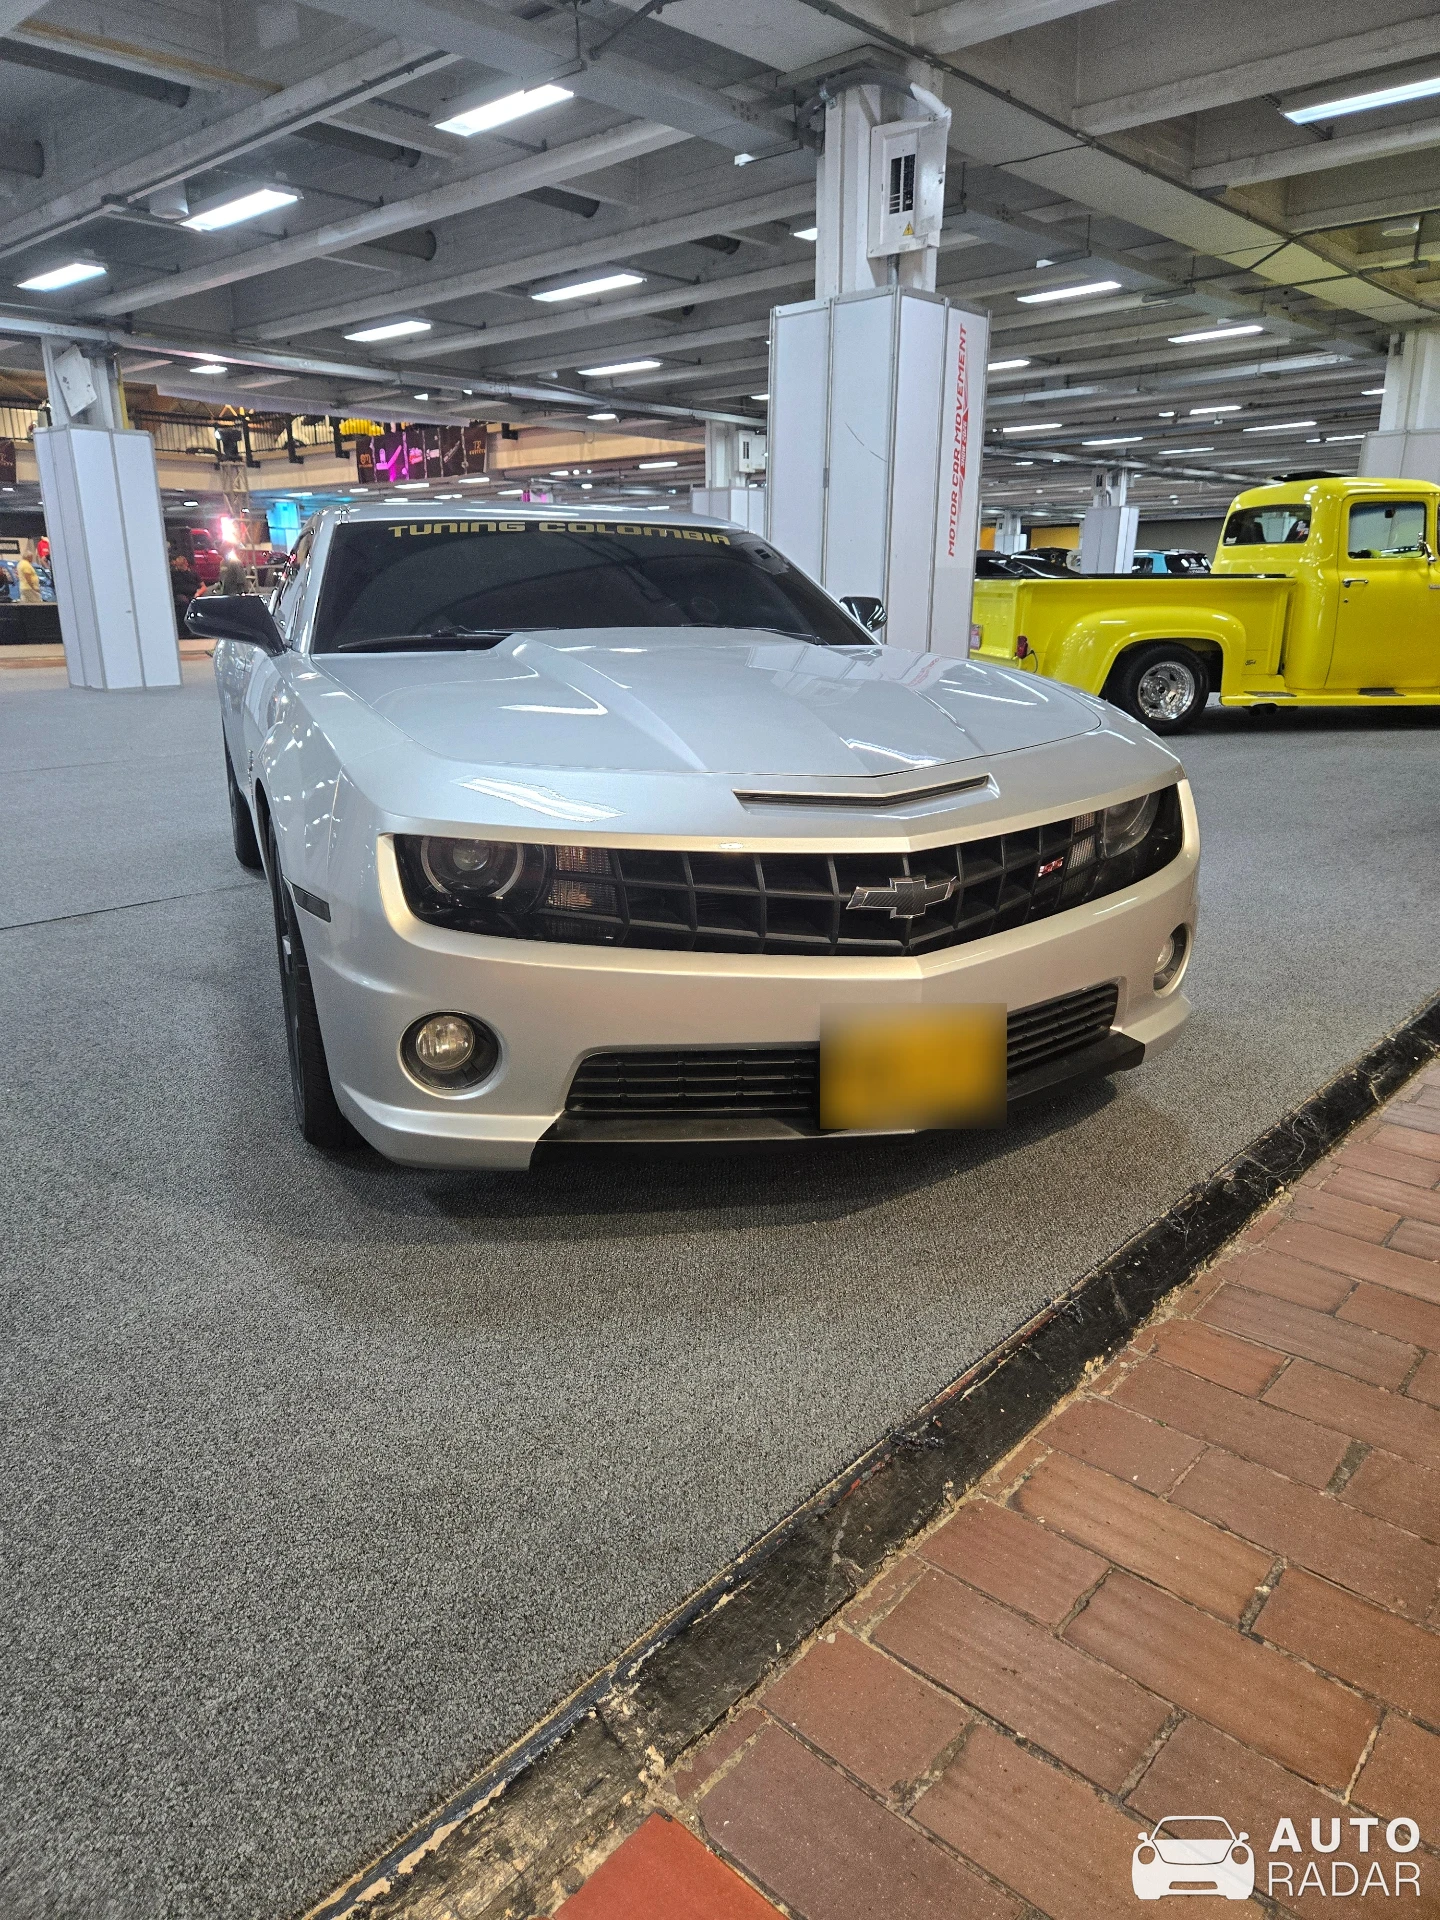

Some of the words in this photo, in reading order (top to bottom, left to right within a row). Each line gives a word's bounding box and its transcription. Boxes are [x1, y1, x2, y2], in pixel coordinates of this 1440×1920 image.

[953, 323, 967, 444] MOVEMENT
[952, 448, 961, 488] CAR
[959, 445, 968, 468] SHOW
[387, 521, 526, 538] TUNING
[538, 521, 731, 546] COLOMBIA
[947, 493, 958, 557] MOTOR
